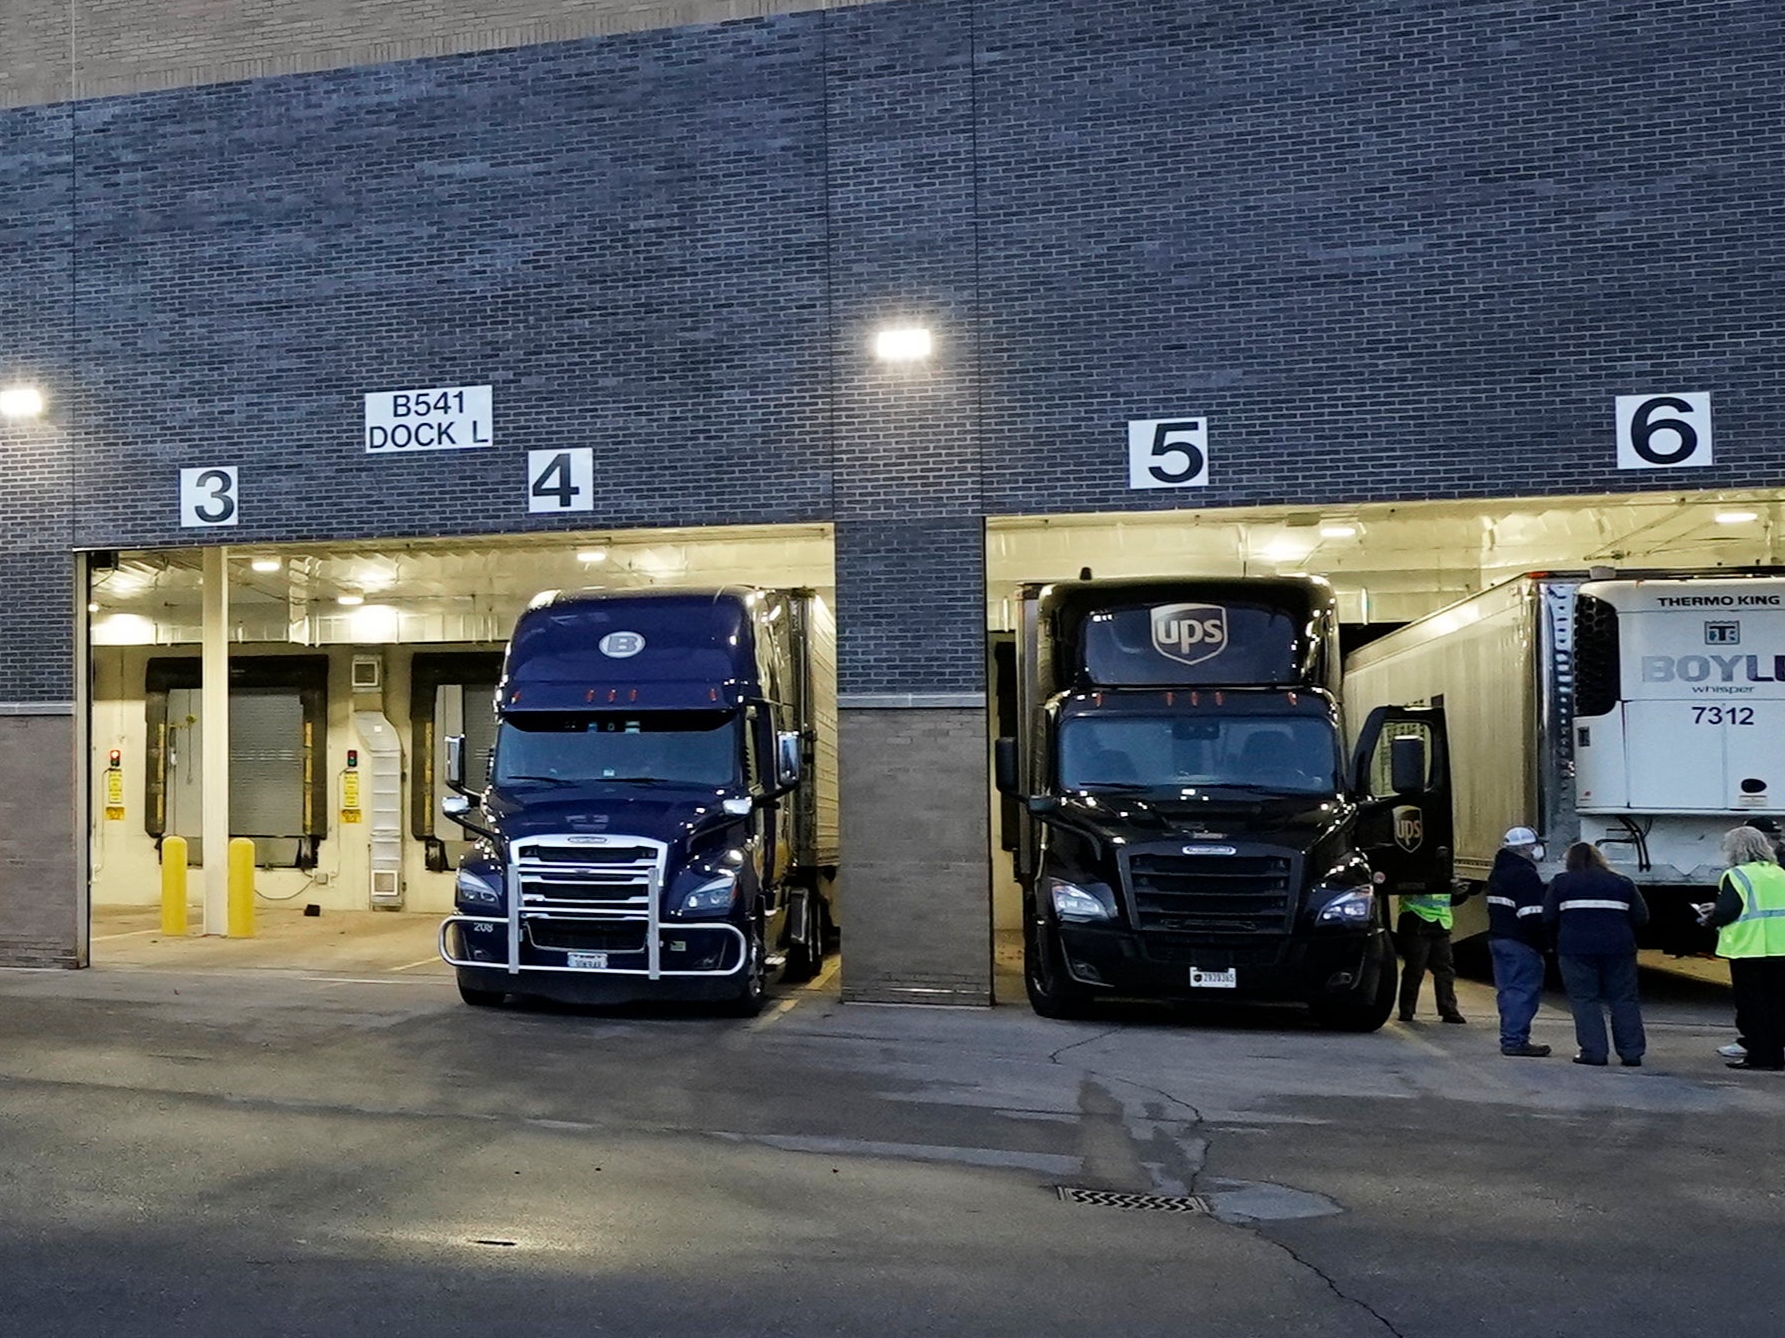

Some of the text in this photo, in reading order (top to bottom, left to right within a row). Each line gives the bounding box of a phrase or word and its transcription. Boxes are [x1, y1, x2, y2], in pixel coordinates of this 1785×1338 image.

[393, 391, 464, 417] B541
[369, 420, 489, 449] DOCK L
[1630, 396, 1698, 465] 6
[1148, 421, 1204, 484] 5
[532, 453, 580, 508] 4
[194, 469, 235, 523] 3
[1656, 595, 1781, 607] THERMO KING
[607, 635, 639, 653] B
[1157, 619, 1223, 654] ups
[1691, 684, 1755, 695] whisper
[1691, 706, 1755, 726] 7312
[1396, 820, 1423, 847] ups
